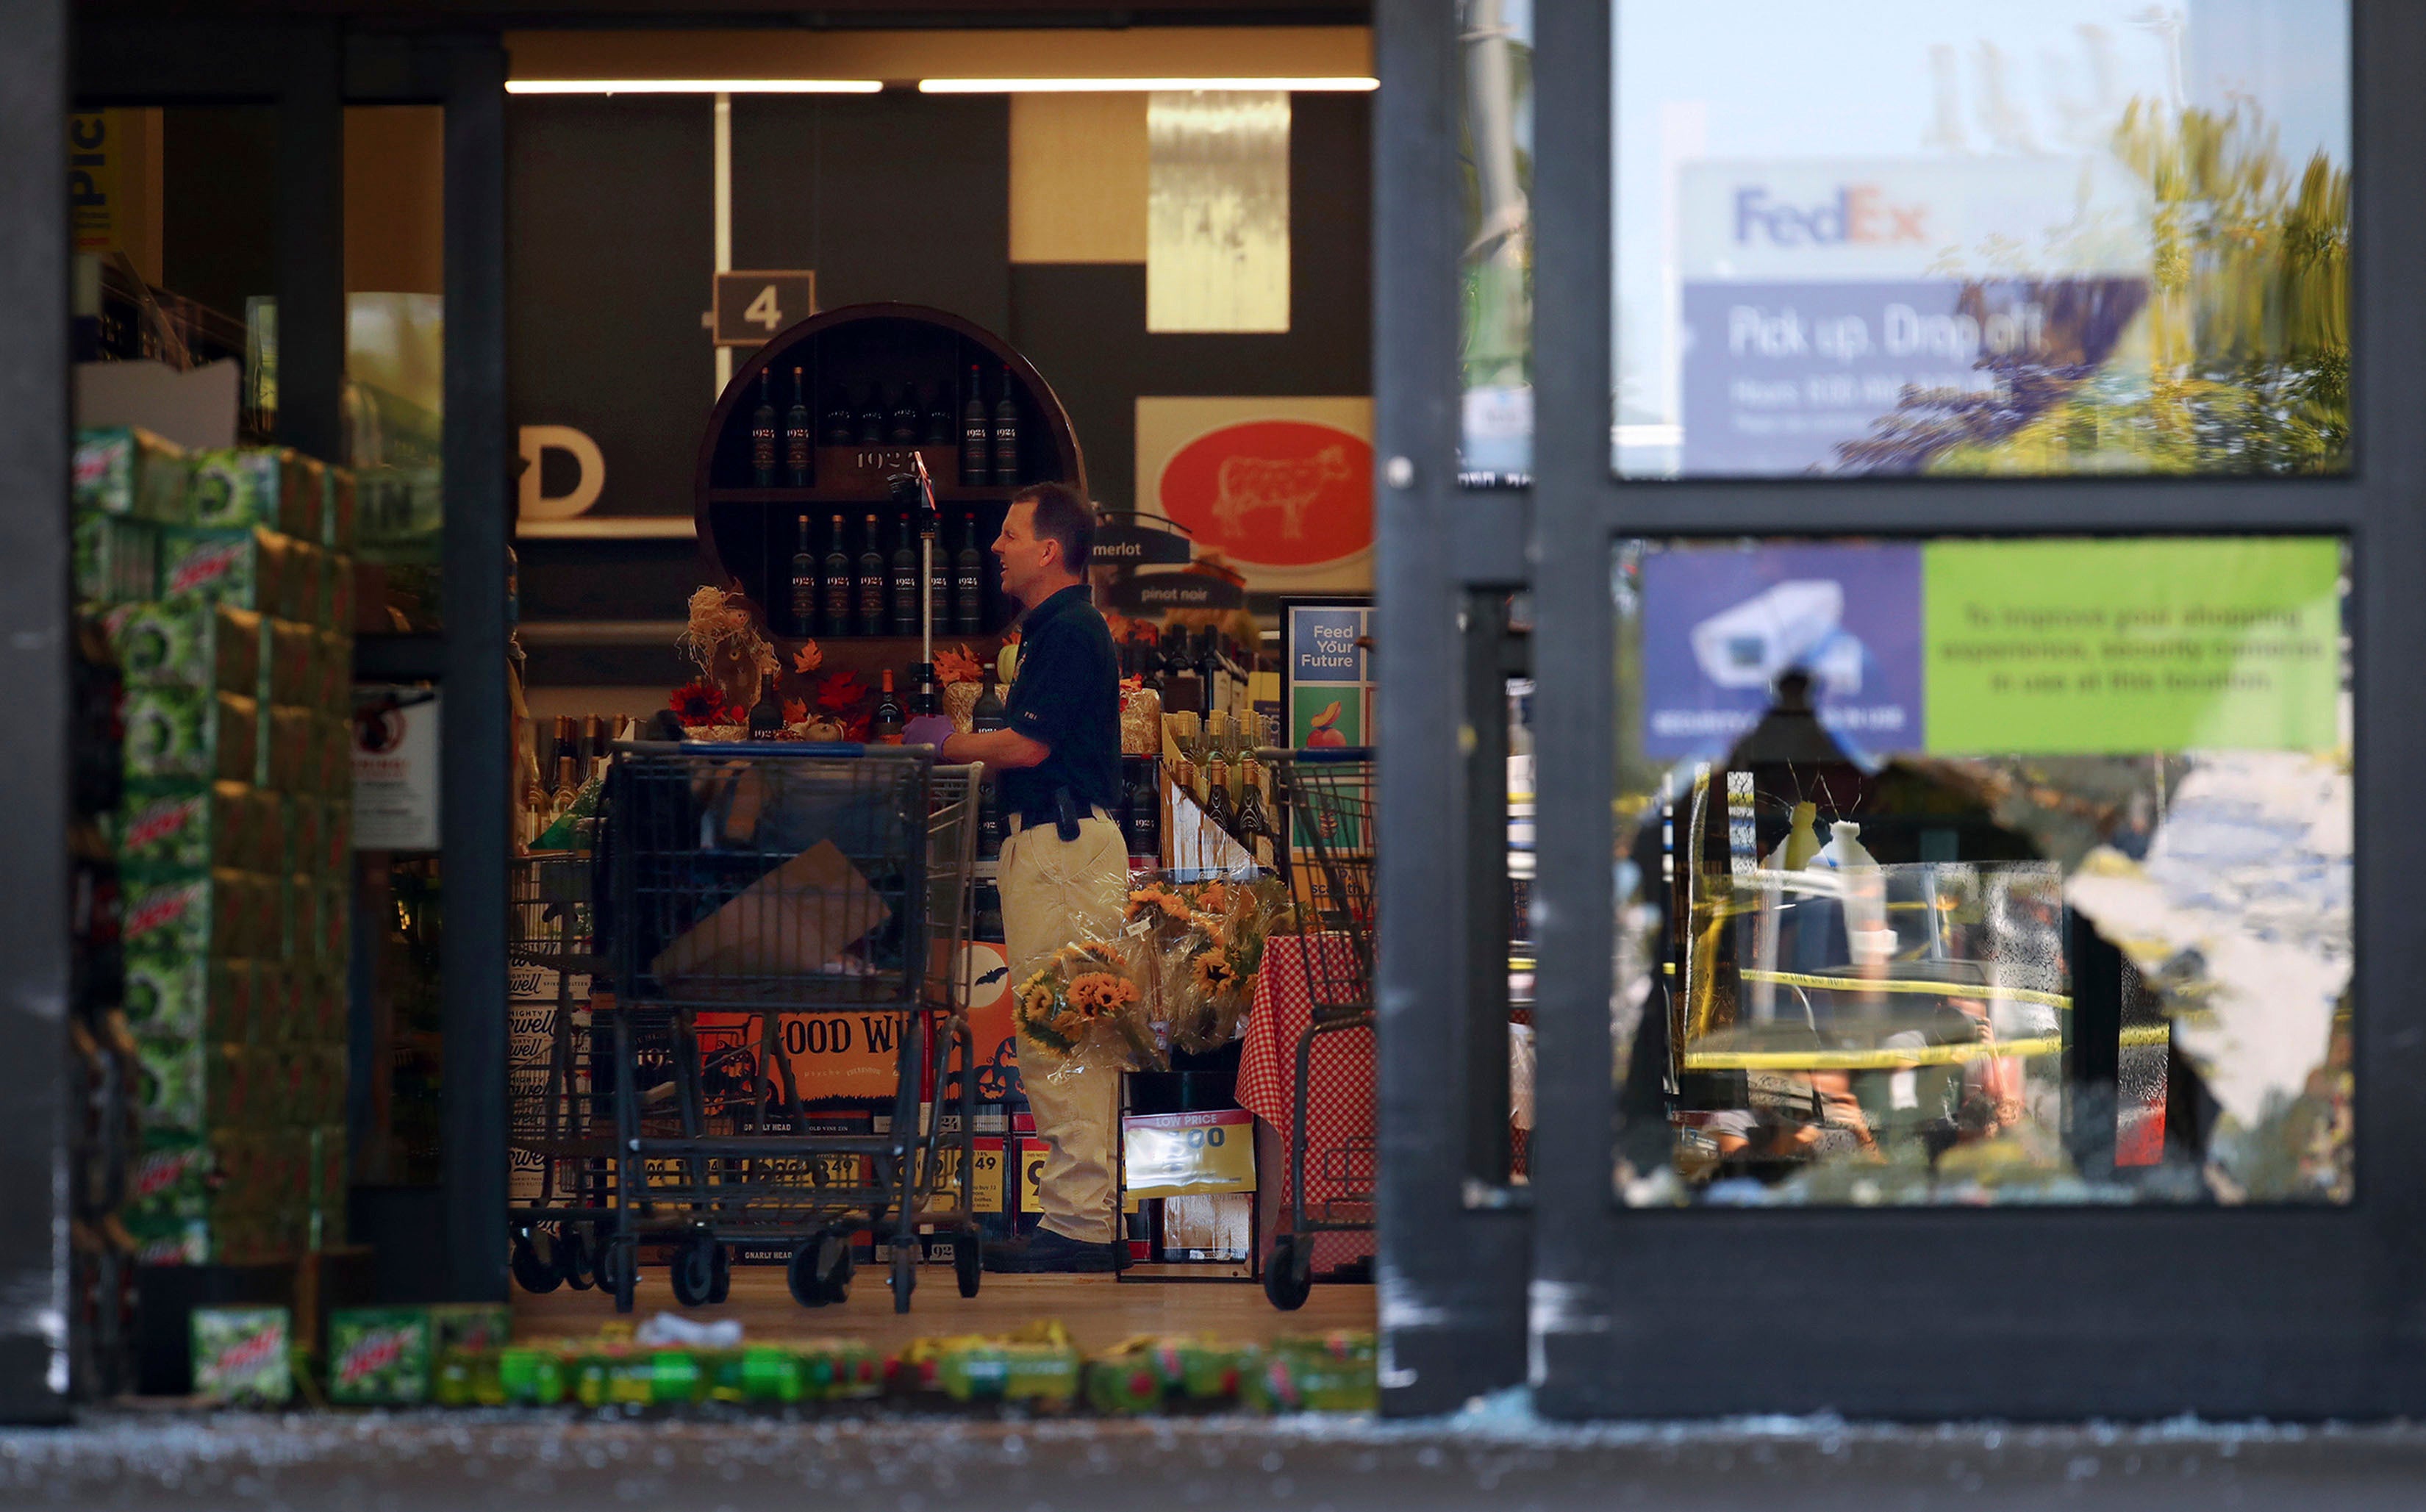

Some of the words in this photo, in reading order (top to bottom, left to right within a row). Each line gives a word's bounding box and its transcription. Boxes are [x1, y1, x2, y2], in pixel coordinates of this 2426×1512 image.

[1733, 184, 1928, 247] FedEx
[743, 284, 782, 330] 4
[1729, 304, 1806, 357] Pick
[1884, 302, 1981, 362] Drop
[967, 429, 986, 438] 1924
[996, 428, 1016, 438] 1924
[1093, 542, 1142, 556] merlot
[792, 576, 815, 587] 1924
[826, 576, 849, 587] 1924
[860, 576, 883, 587] 1924
[895, 577, 915, 587] 1924
[931, 576, 948, 586] 924
[958, 576, 978, 586] 1924
[1142, 587, 1176, 602] pinot
[1180, 588, 1208, 601] noir
[1314, 626, 1353, 638] Feed
[1301, 654, 1353, 667] Future
[509, 974, 542, 994] well
[779, 1019, 851, 1054] OOD
[509, 1039, 542, 1056] well
[773, 1123, 792, 1131] HEAD
[1156, 1117, 1181, 1128] LOW
[1184, 1114, 1217, 1126] PRICE
[975, 1157, 996, 1170] 49
[745, 1251, 773, 1259] GNARLY
